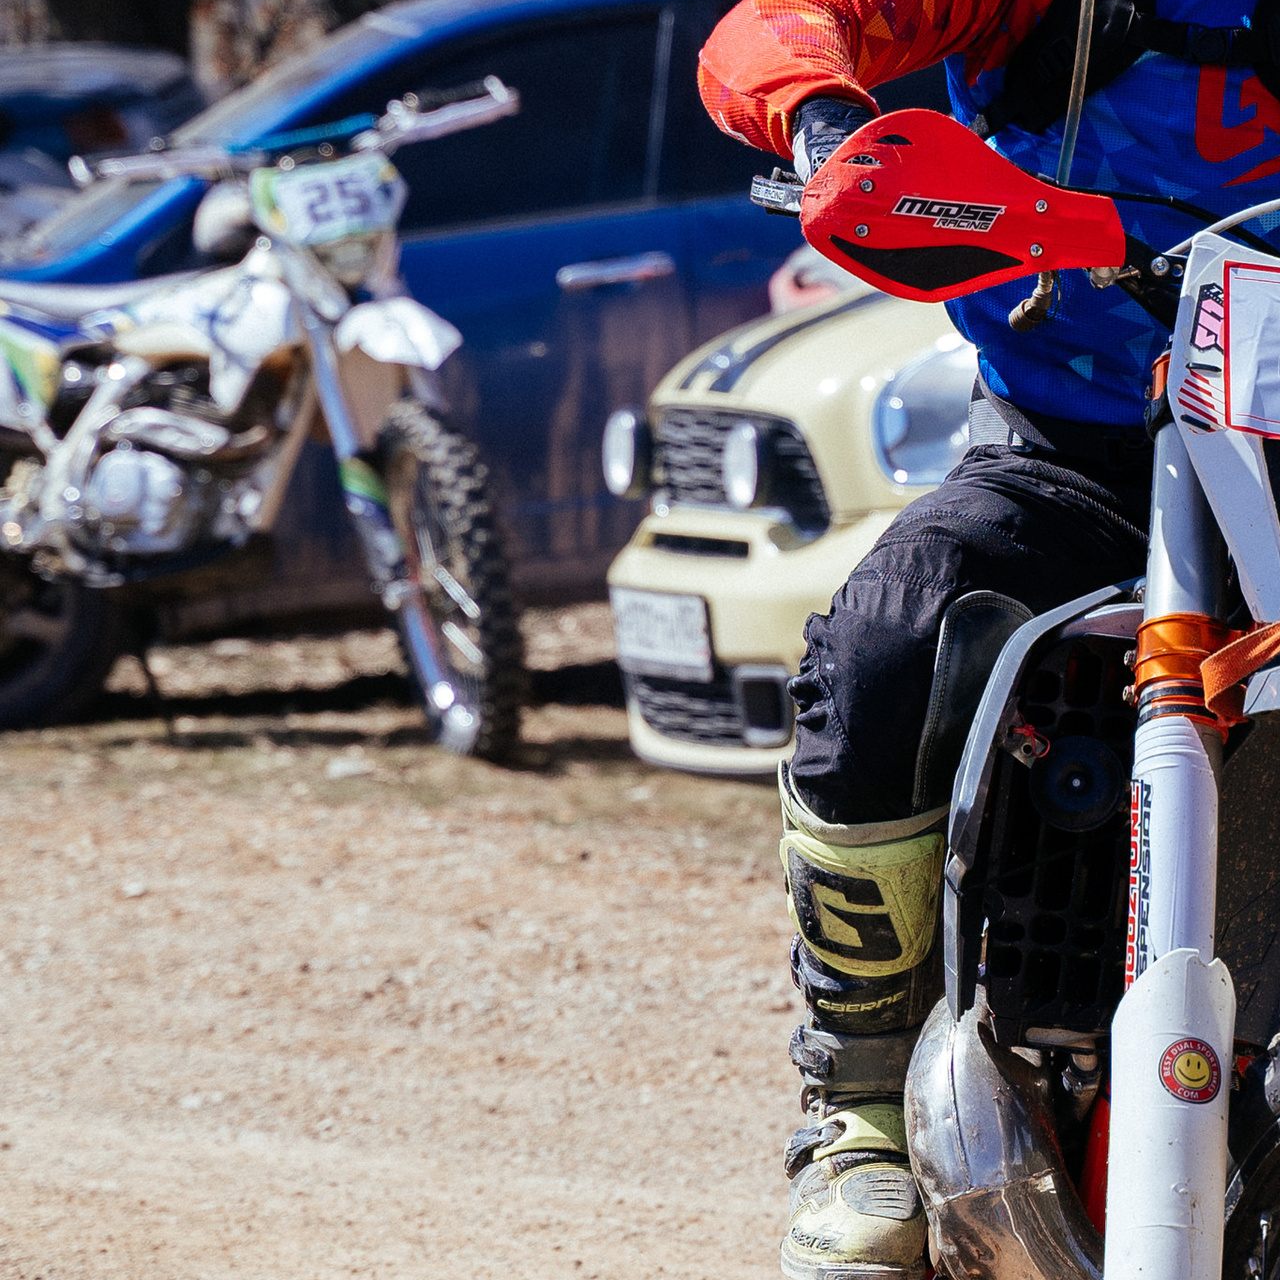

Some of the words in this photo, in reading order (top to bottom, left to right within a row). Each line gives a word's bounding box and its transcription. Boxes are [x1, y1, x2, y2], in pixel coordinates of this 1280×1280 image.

[894, 197, 1003, 222] MOOSE
[936, 219, 991, 231] RACING
[1163, 1055, 1173, 1077] BEST
[1171, 1041, 1194, 1056] DUAL
[1196, 1043, 1217, 1067] SPORT
[1207, 1070, 1218, 1094] BIKES
